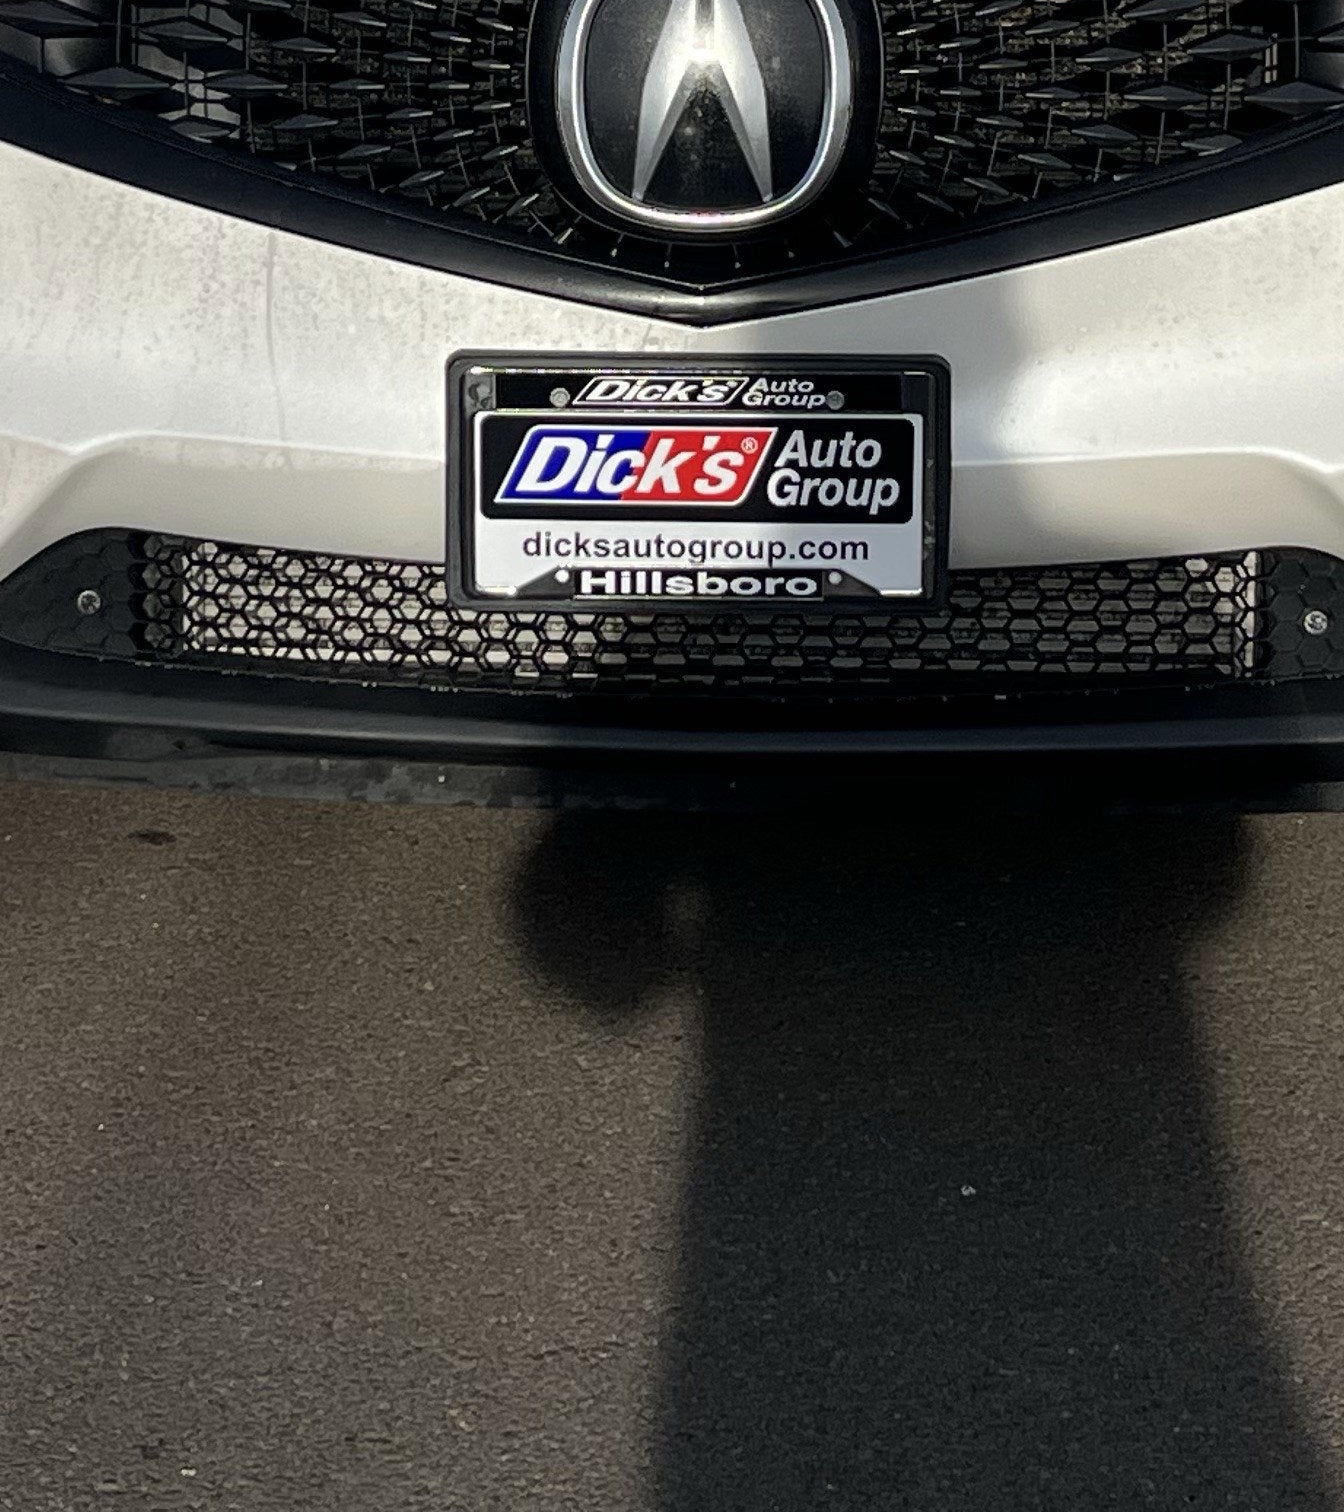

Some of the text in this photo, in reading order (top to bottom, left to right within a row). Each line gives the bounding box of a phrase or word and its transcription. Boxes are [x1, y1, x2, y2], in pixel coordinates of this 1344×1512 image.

[748, 377, 814, 393] Auto
[742, 392, 827, 409] Group
[774, 430, 882, 469] Auto
[767, 471, 900, 515] Group
[522, 531, 870, 564] dicksautogroup.com
[579, 570, 818, 596] Hillsboro
